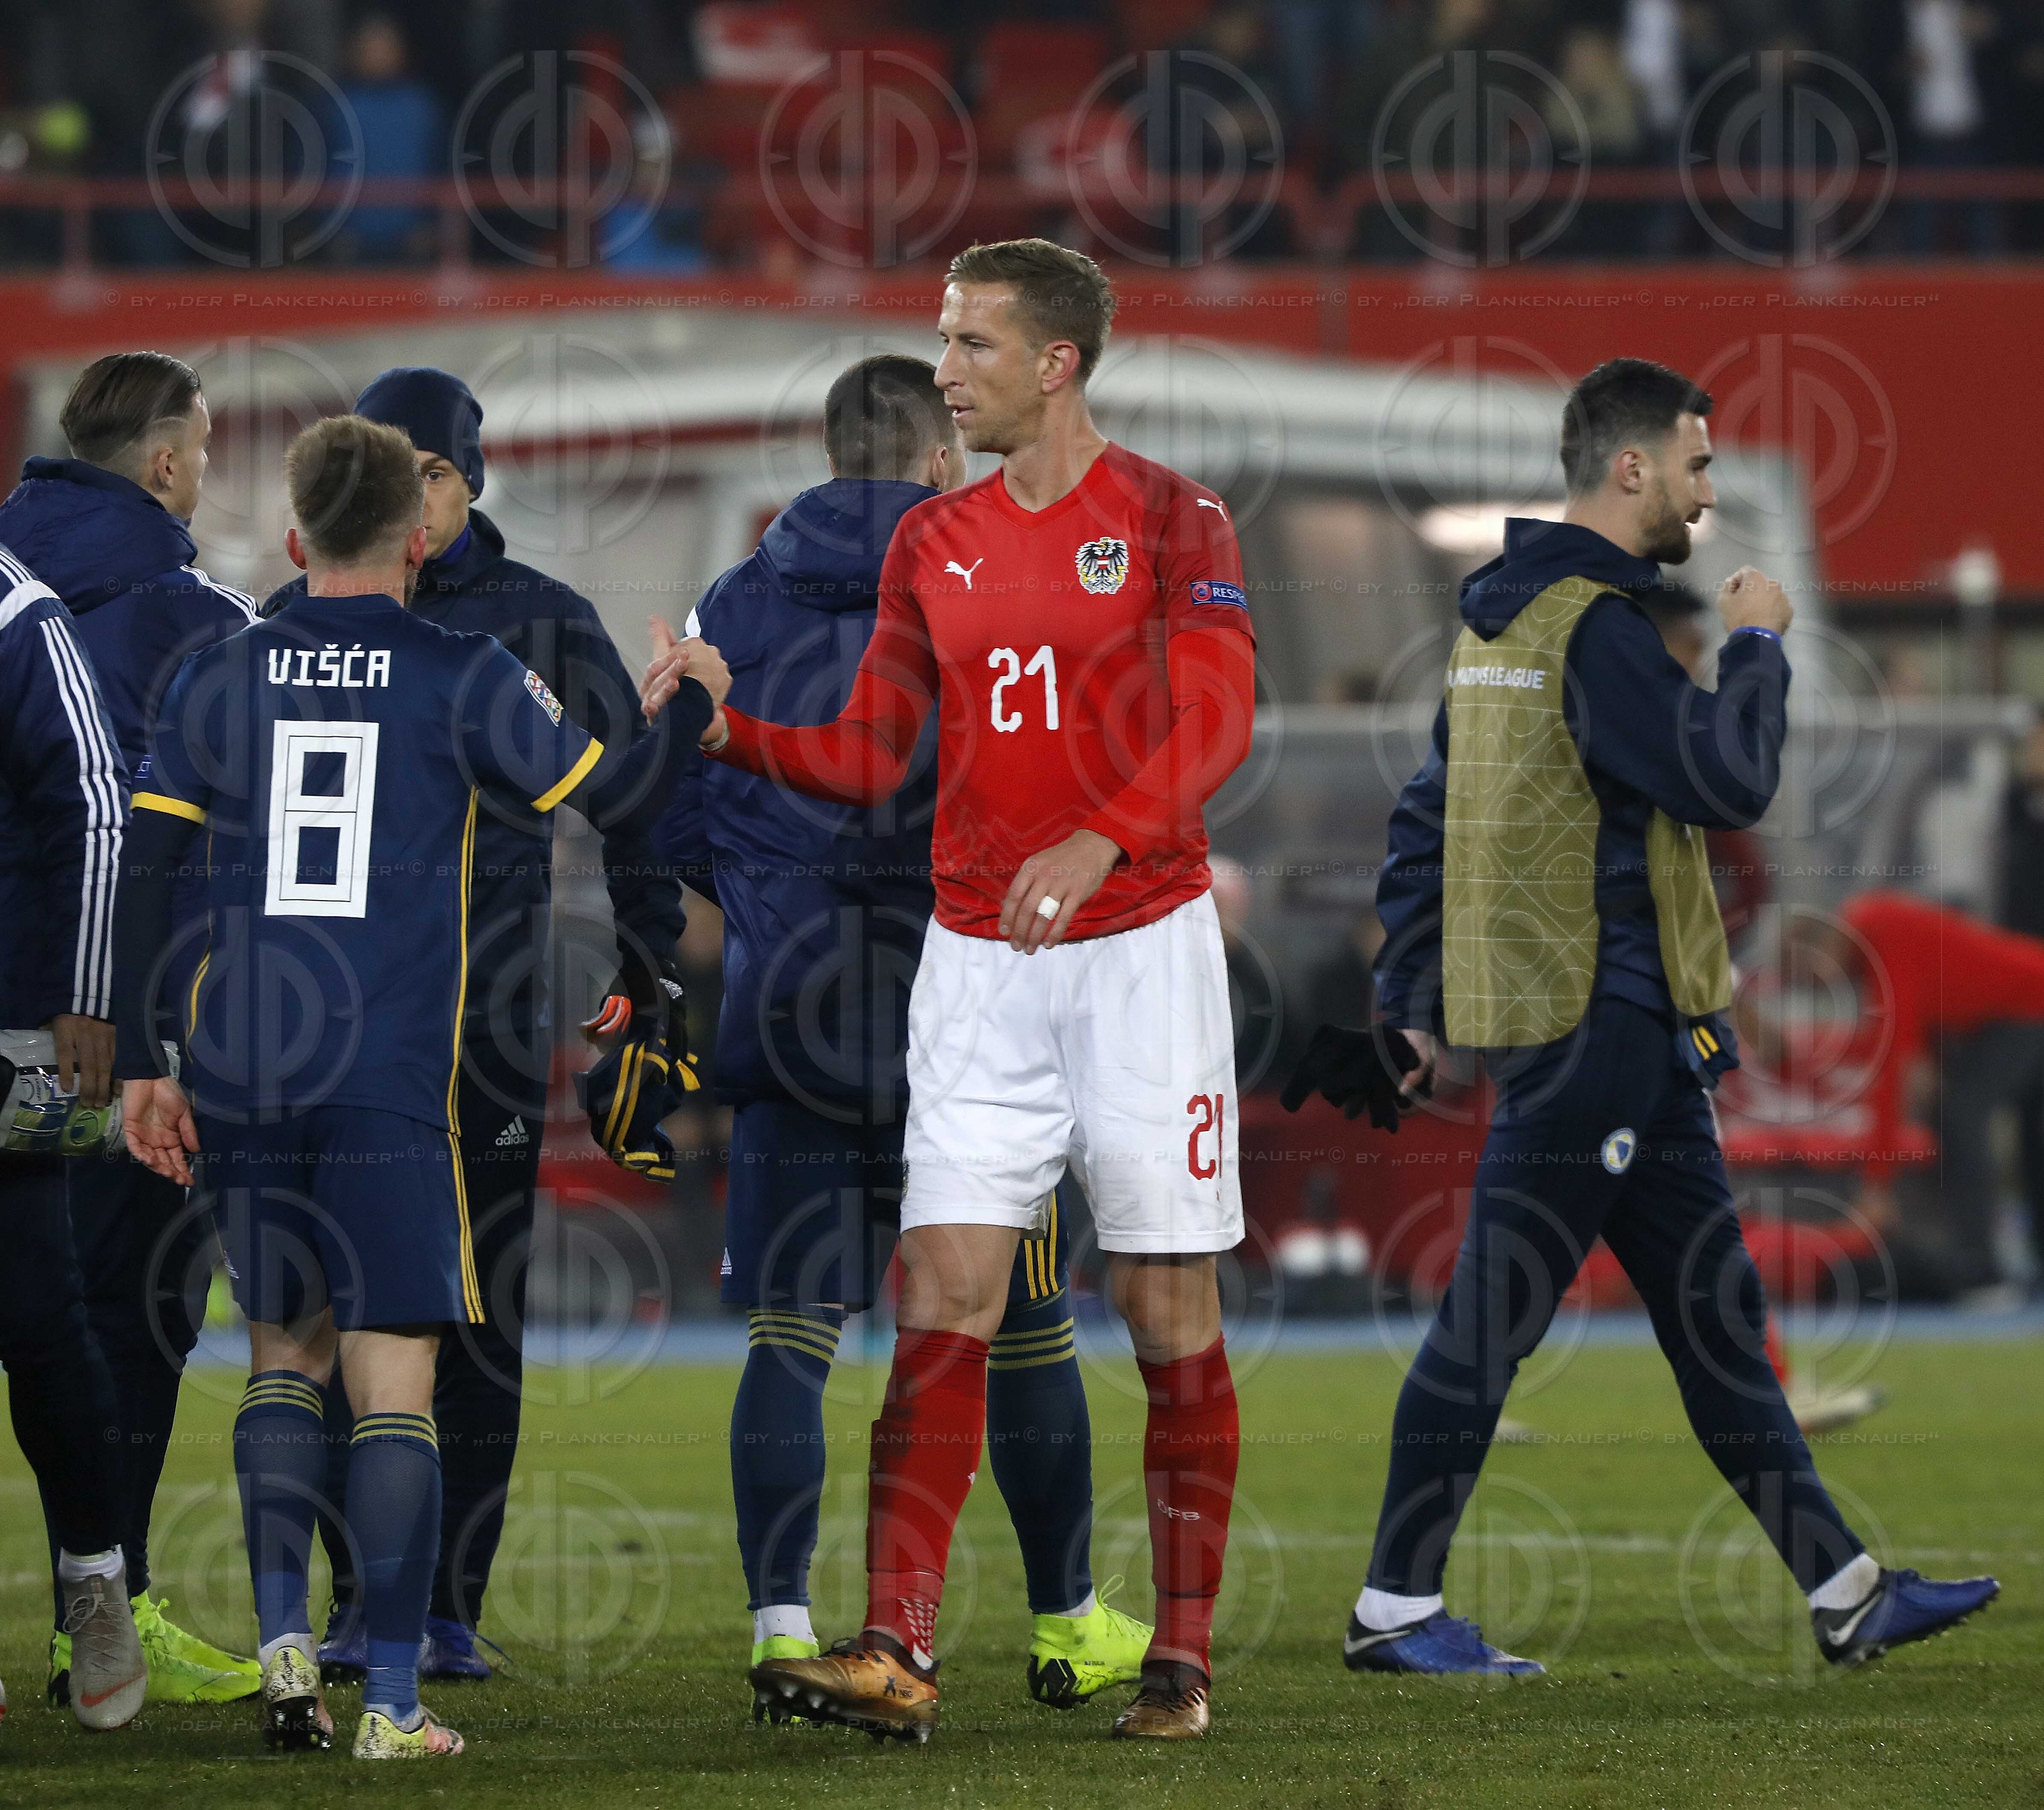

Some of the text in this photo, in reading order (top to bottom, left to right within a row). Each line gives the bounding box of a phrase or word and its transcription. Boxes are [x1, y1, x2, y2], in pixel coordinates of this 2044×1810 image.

[268, 643, 391, 687] VIŠĆA
[987, 645, 1060, 733] 21
[264, 719, 380, 919] 8
[495, 1134, 529, 1146] adidas
[1187, 1094, 1223, 1180] 21
